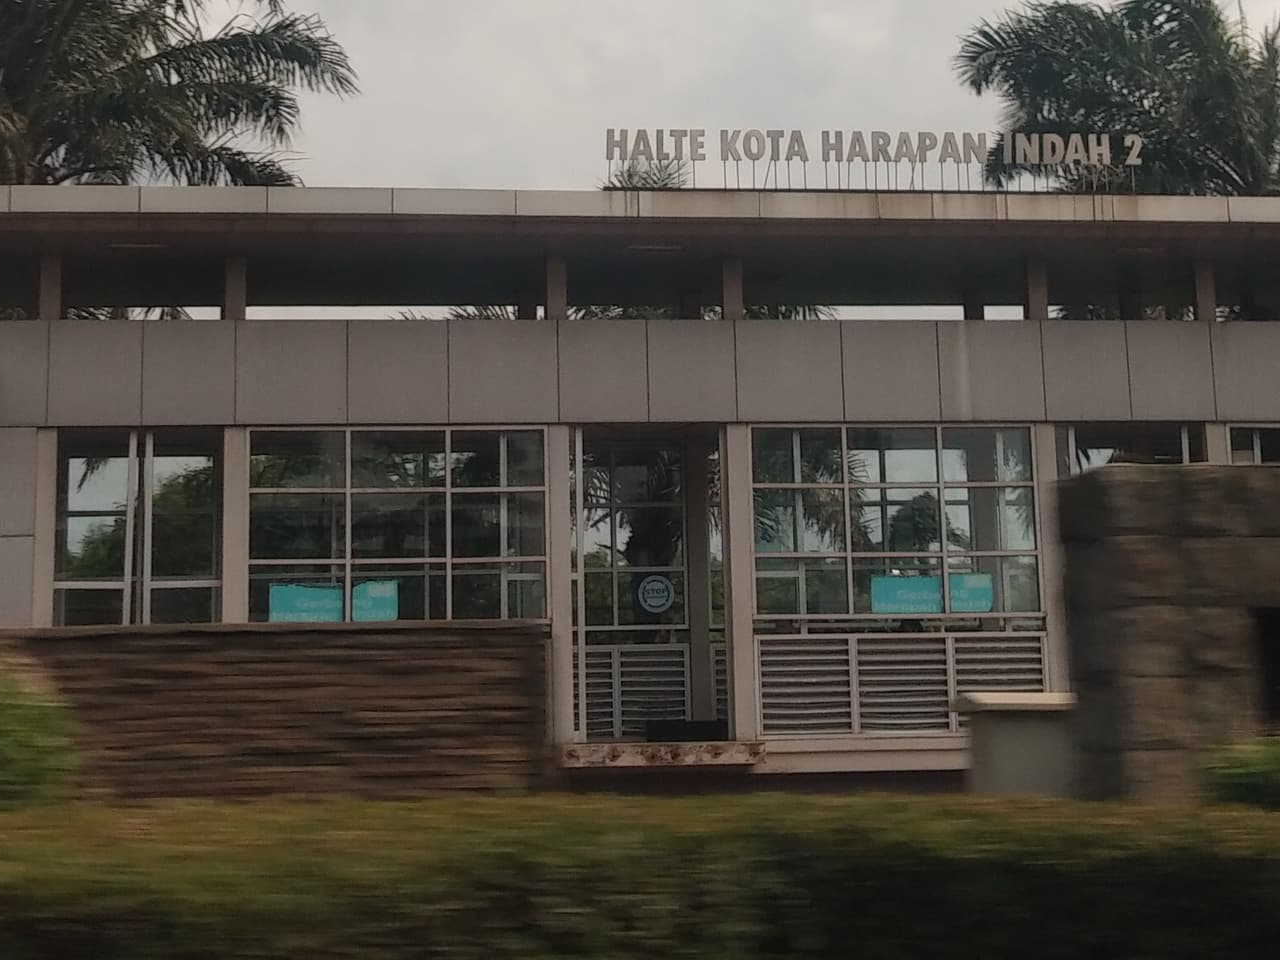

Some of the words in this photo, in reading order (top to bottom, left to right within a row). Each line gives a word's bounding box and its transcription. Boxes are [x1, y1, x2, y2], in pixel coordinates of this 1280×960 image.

[605, 128, 706, 161] HALTE
[720, 129, 809, 162] KOTA
[821, 130, 988, 164] HARAPAN
[1004, 133, 1111, 166] INDAH
[1124, 134, 1143, 166] 2
